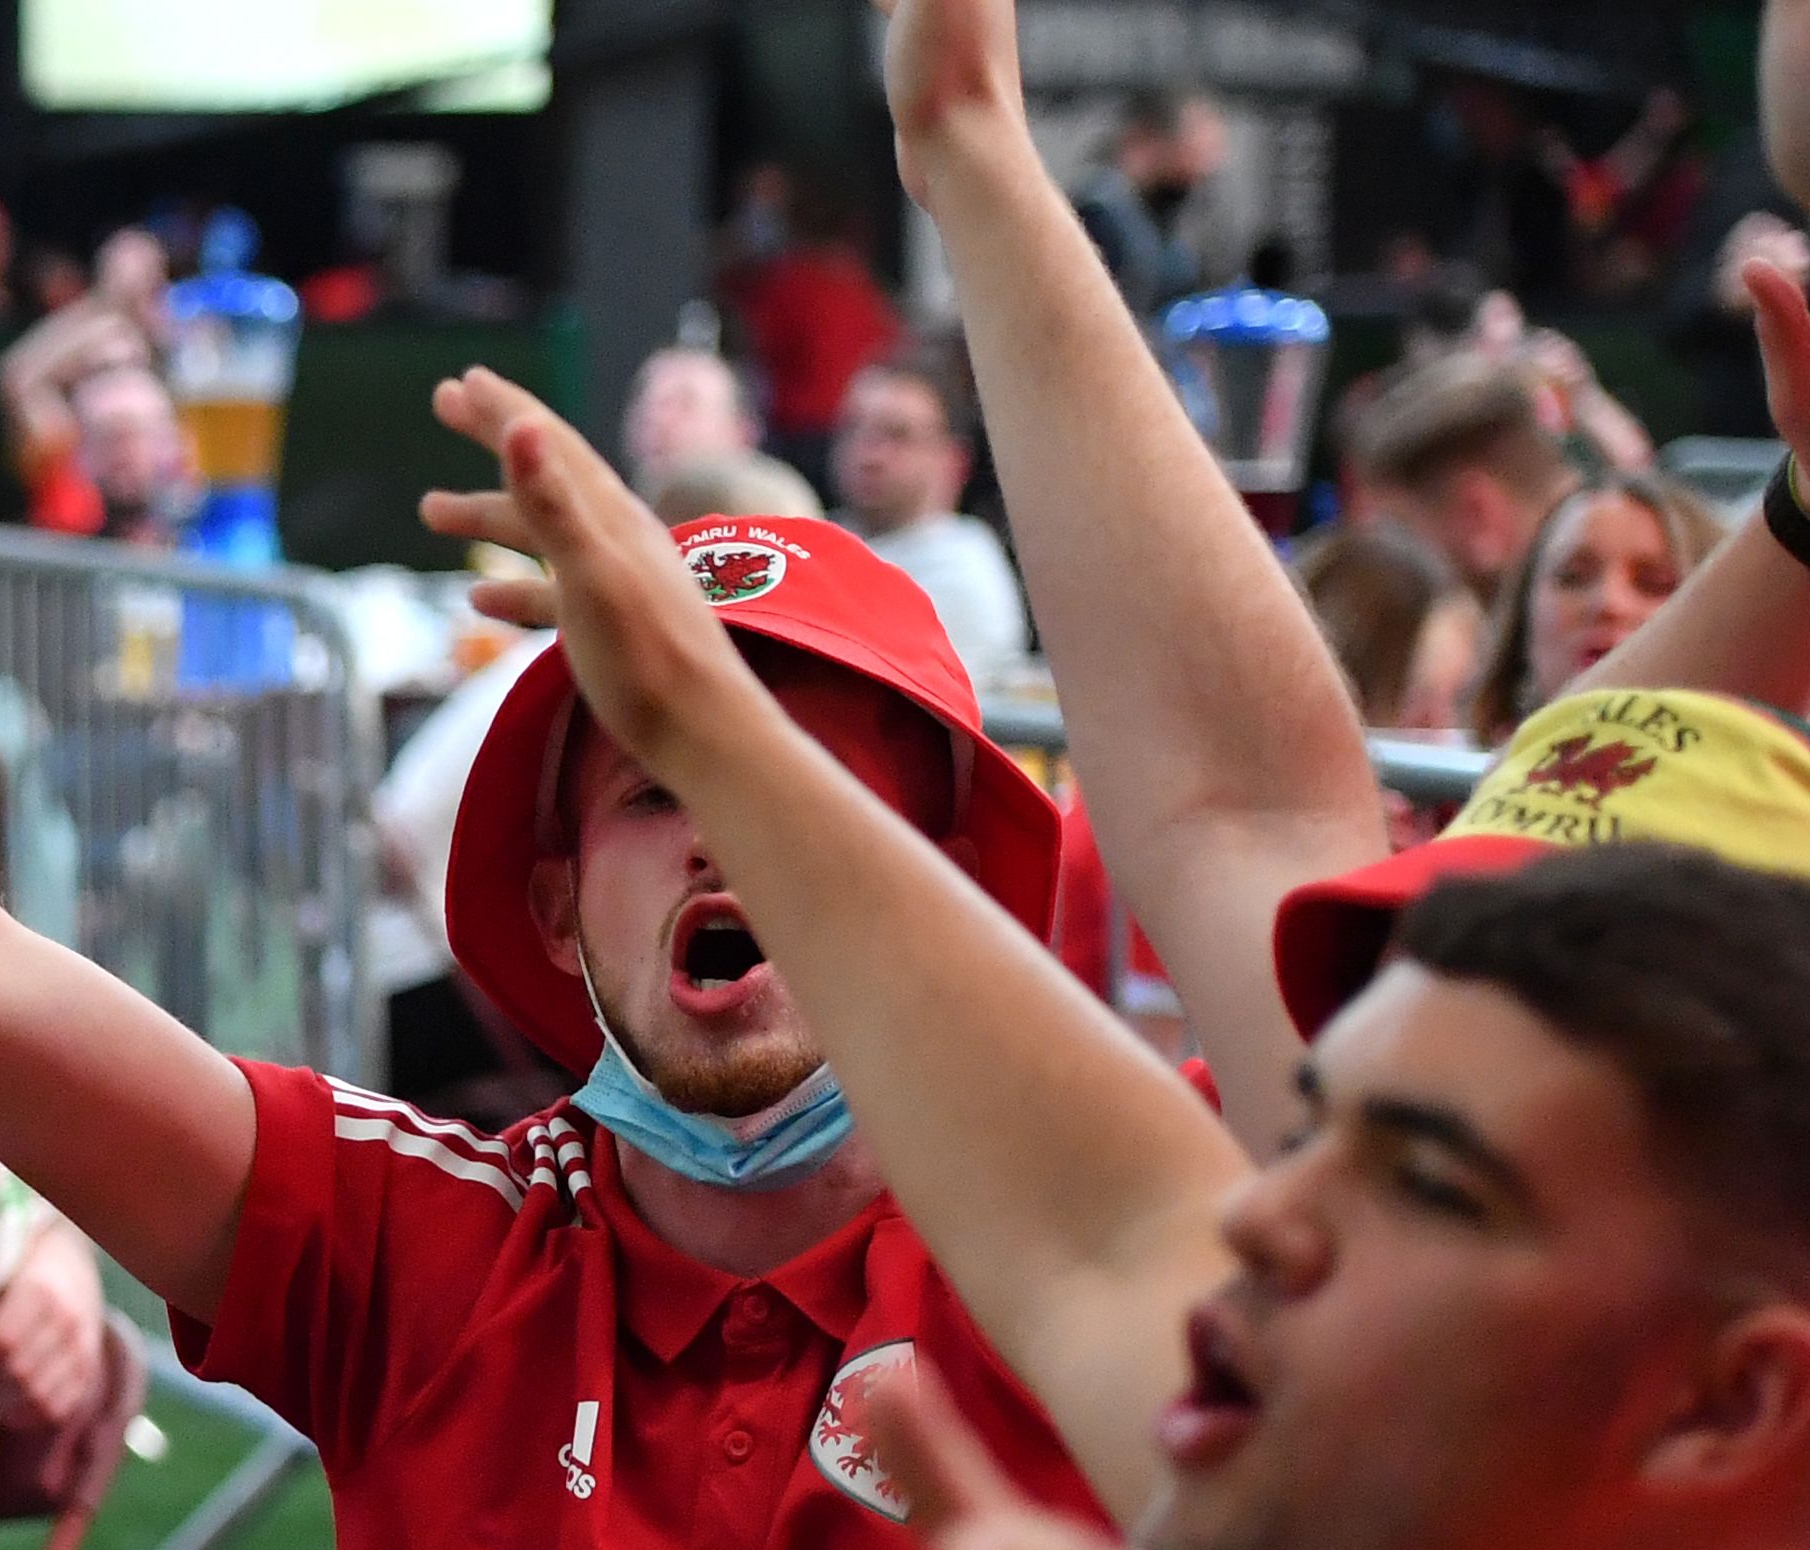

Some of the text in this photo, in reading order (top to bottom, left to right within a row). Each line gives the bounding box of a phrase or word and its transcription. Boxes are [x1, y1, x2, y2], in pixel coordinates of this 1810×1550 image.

[676, 525, 811, 560] YMRU WALES
[1591, 694, 1701, 753] ALES
